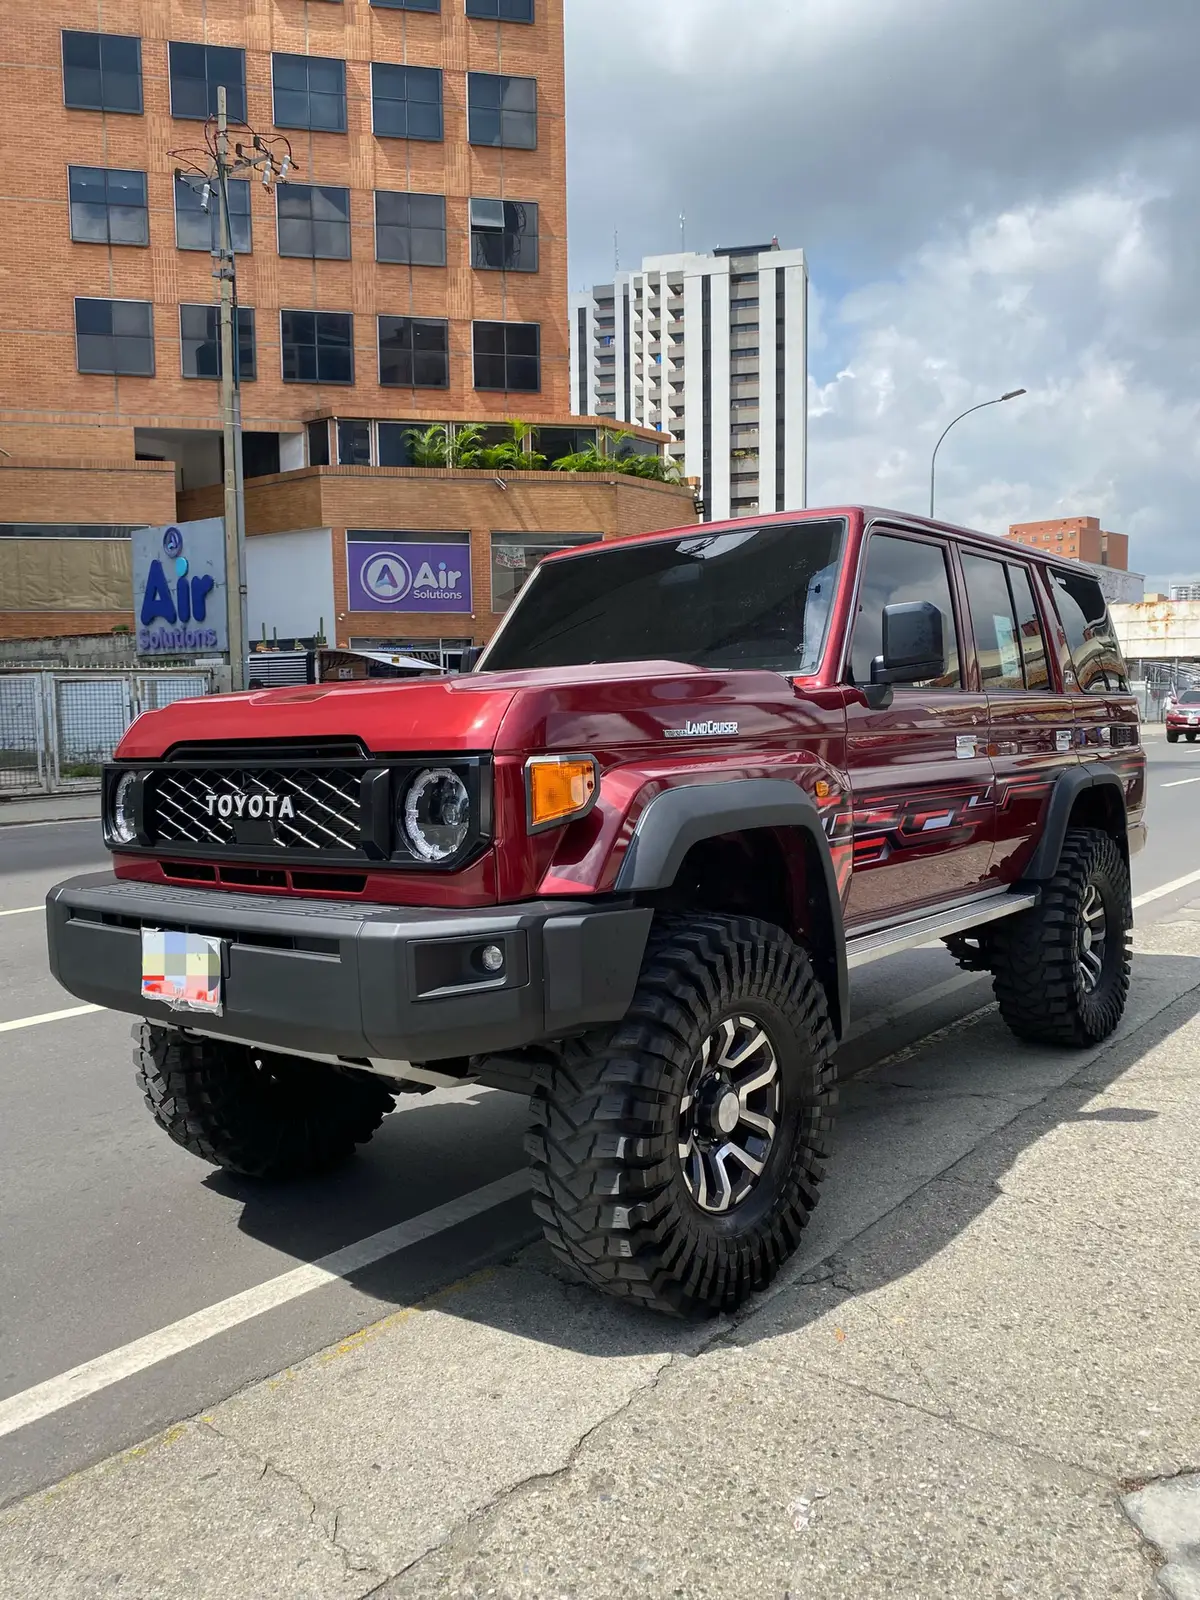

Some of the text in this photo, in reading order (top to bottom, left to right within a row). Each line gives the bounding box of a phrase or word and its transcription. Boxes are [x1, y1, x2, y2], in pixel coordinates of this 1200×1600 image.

[413, 562, 462, 589] Air
[141, 556, 215, 625] Air
[413, 589, 463, 600] Solutions
[139, 627, 218, 650] Solutions
[205, 794, 295, 818] TOYOTA
